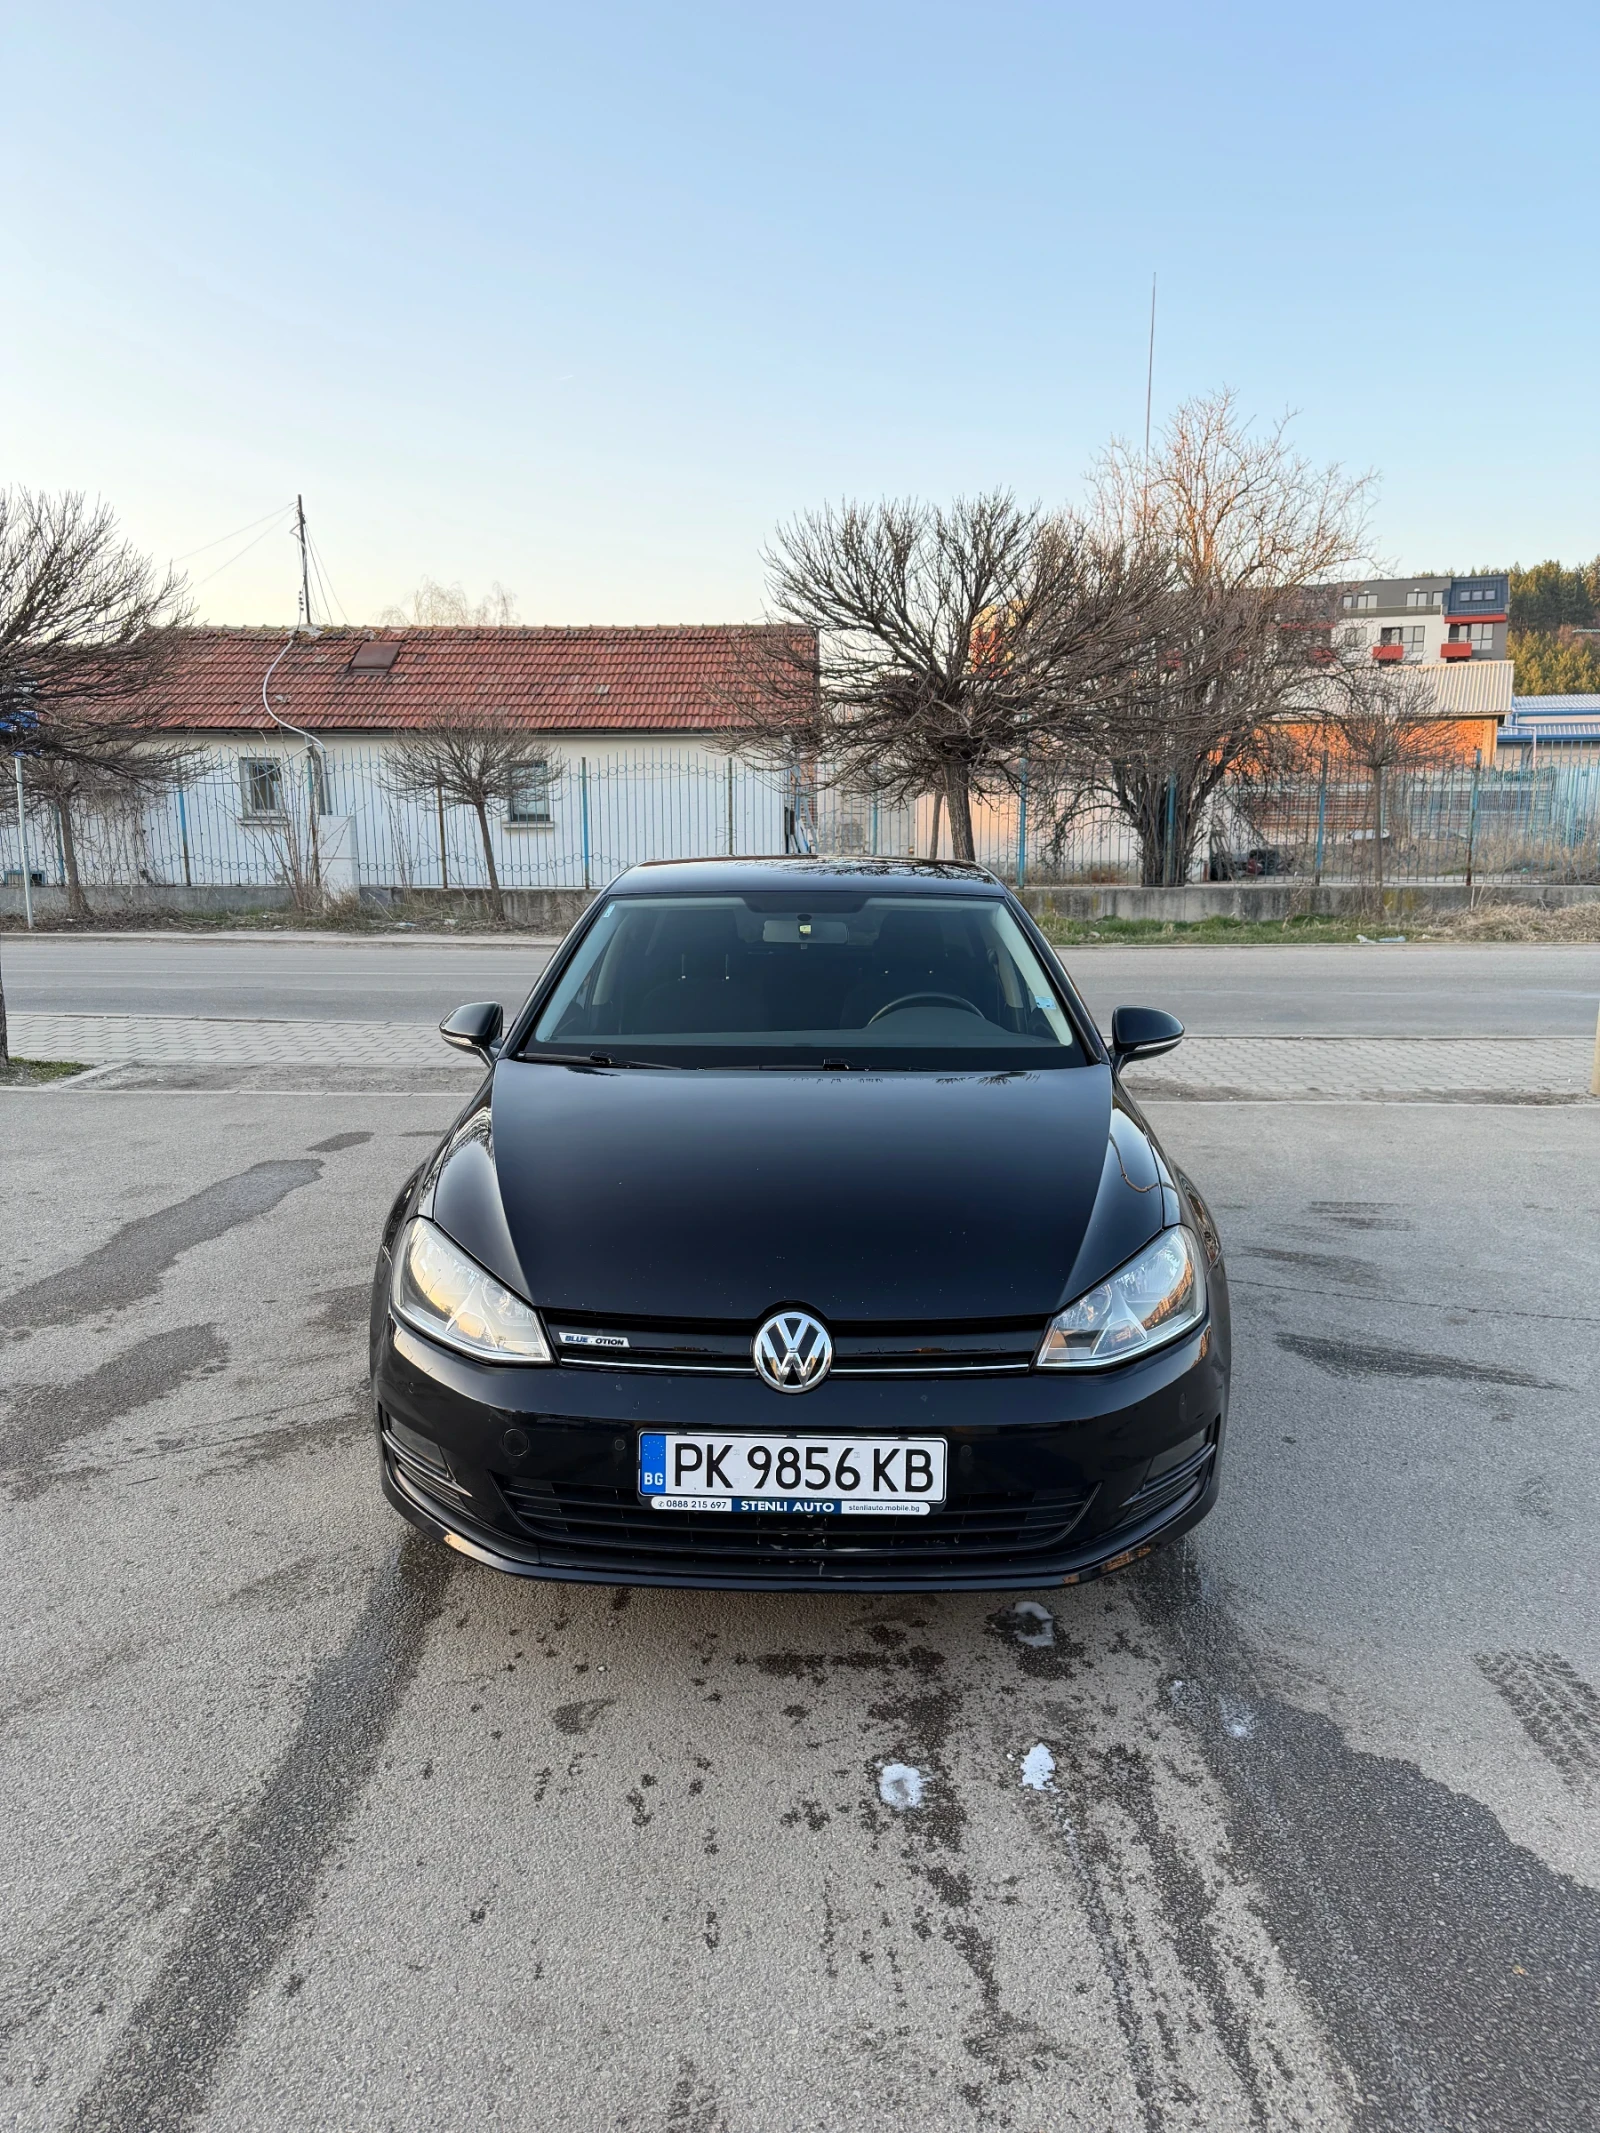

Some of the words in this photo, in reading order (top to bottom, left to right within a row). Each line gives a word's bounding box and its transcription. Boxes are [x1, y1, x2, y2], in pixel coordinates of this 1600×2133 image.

[758, 1312, 831, 1393] VW
[674, 1442, 733, 1489] PK
[747, 1446, 861, 1491] 9856
[872, 1448, 934, 1493] KB
[643, 1472, 664, 1485] BG
[666, 1500, 689, 1508] 0888
[691, 1500, 708, 1508] 215
[710, 1501, 727, 1509] 697
[740, 1500, 788, 1511] STENLI
[792, 1502, 835, 1512] AUTO
[848, 1504, 920, 1512] stenliauto.mobile.bg
